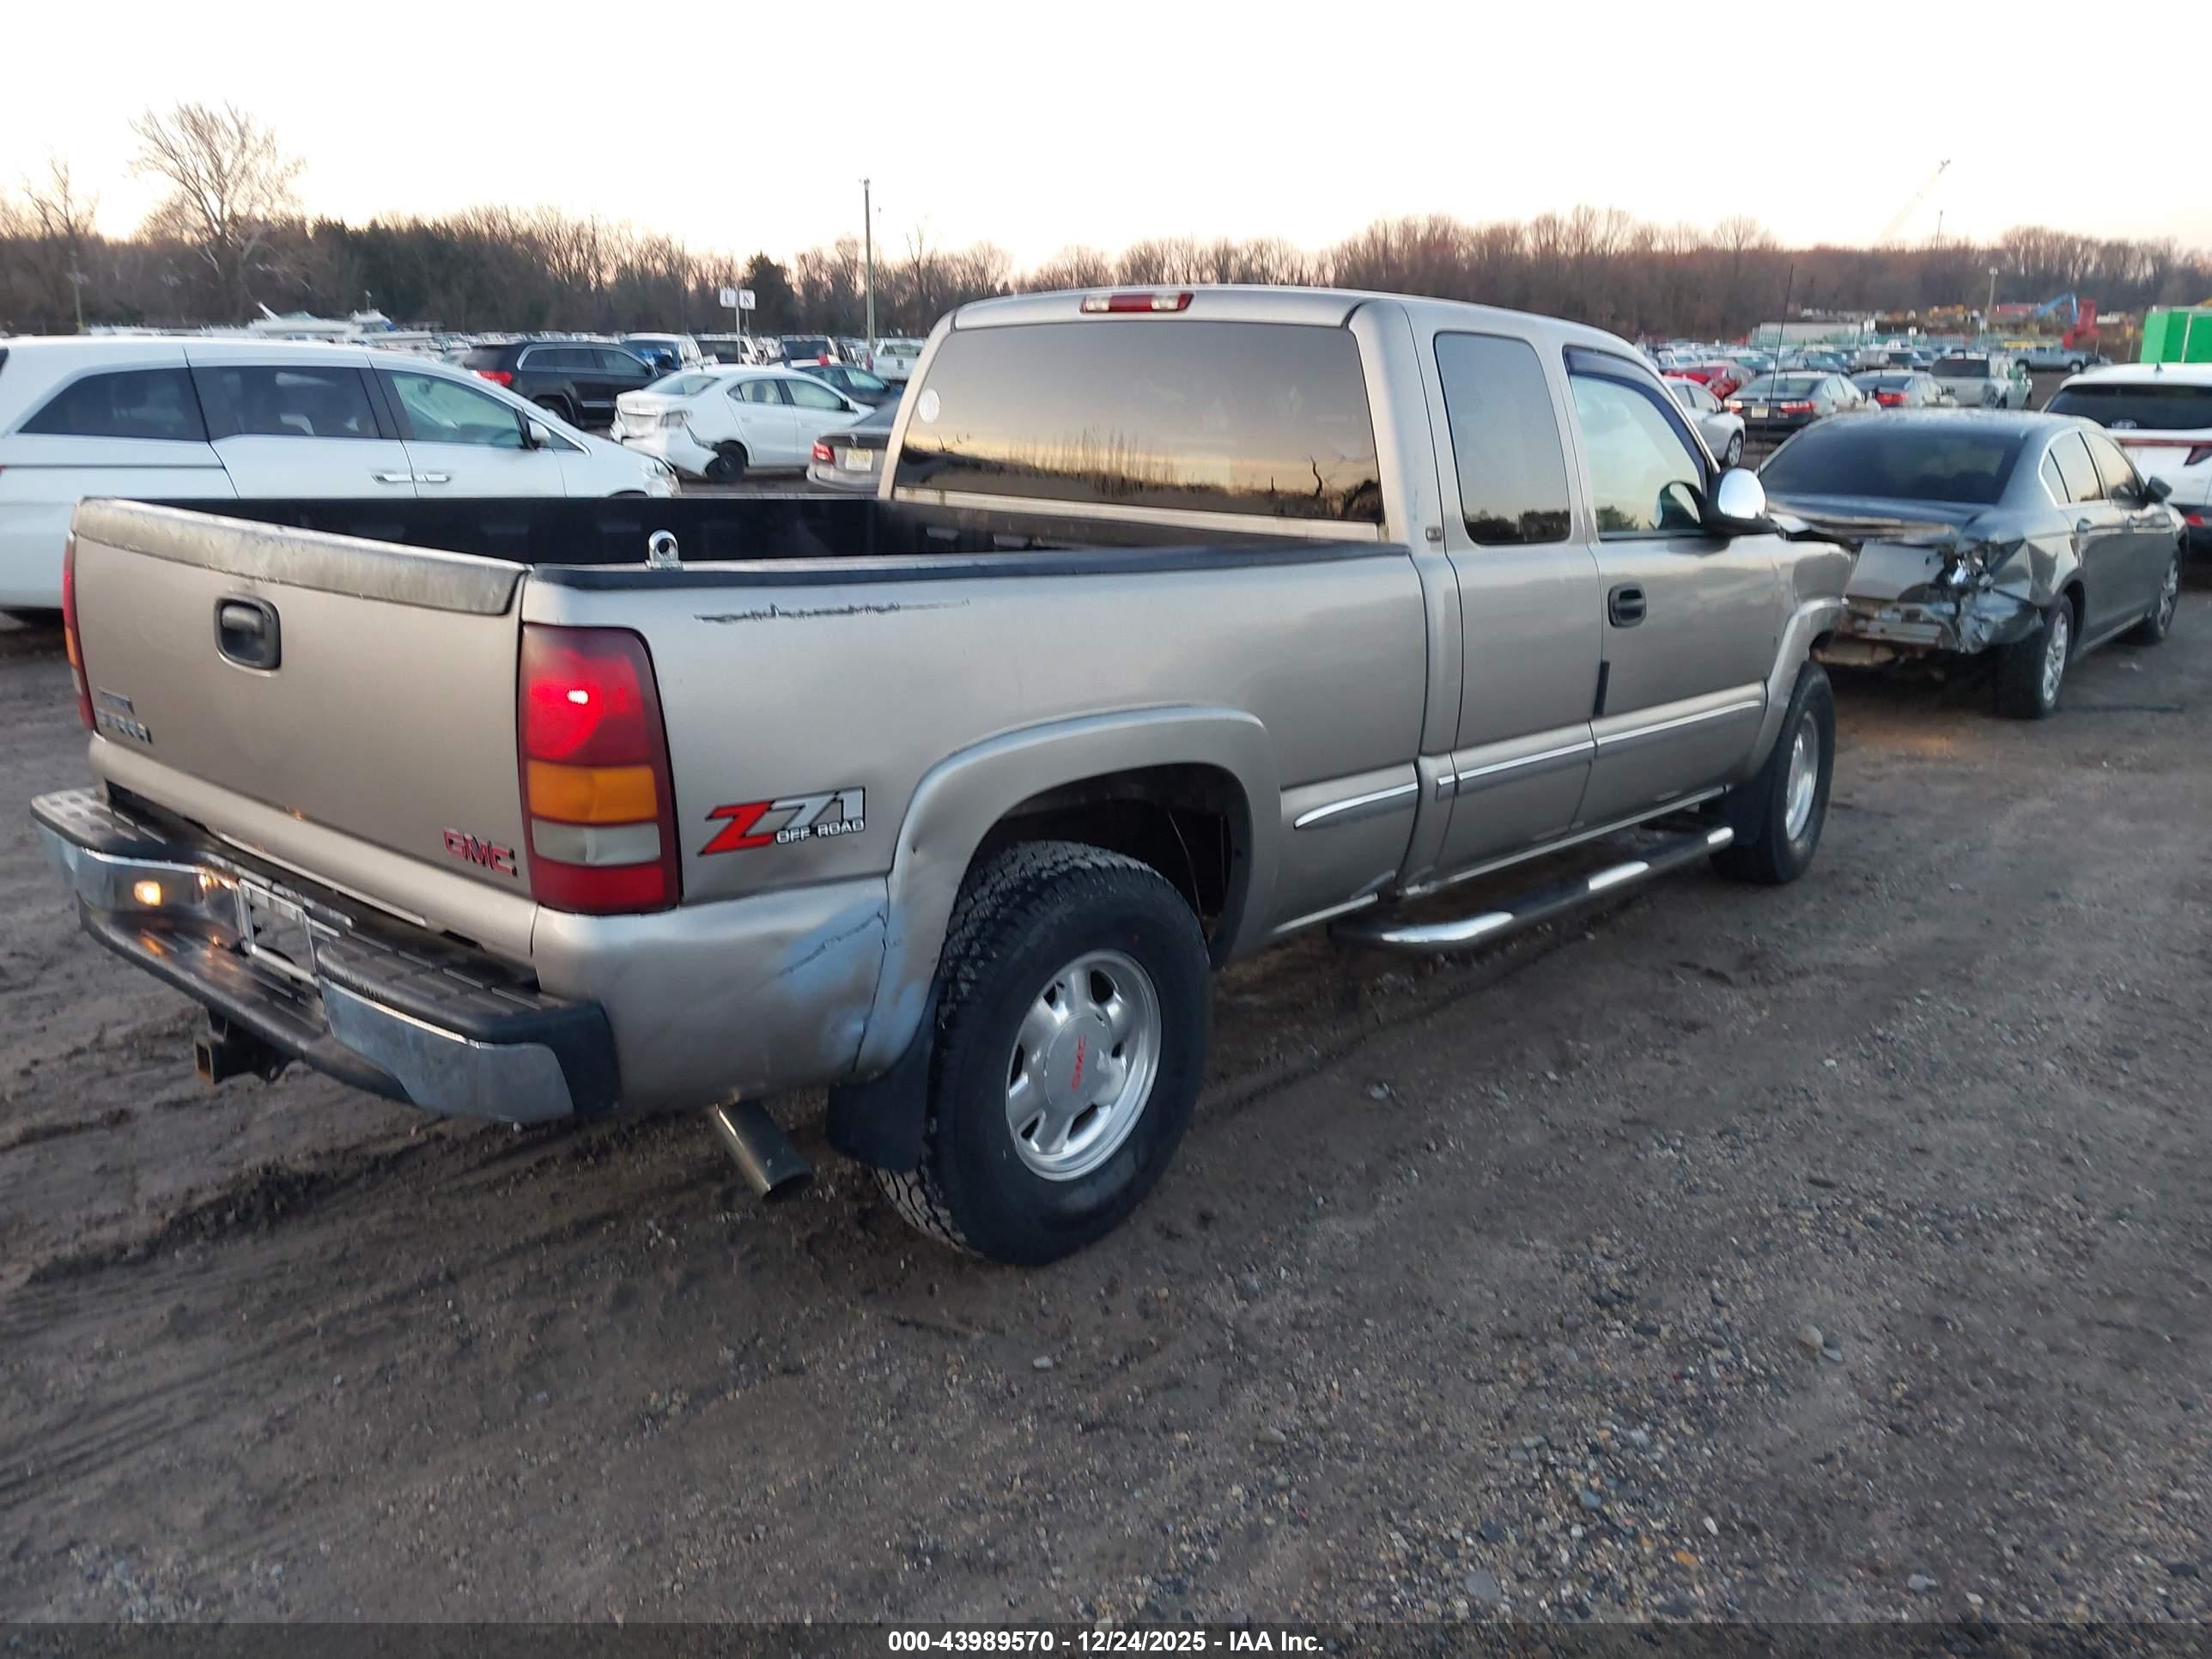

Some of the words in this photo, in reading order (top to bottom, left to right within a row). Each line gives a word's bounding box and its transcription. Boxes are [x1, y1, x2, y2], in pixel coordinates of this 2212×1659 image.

[697, 786, 866, 857] Z71
[776, 825, 811, 844] OFF
[817, 817, 865, 838] ROAD
[442, 829, 517, 878] GMC
